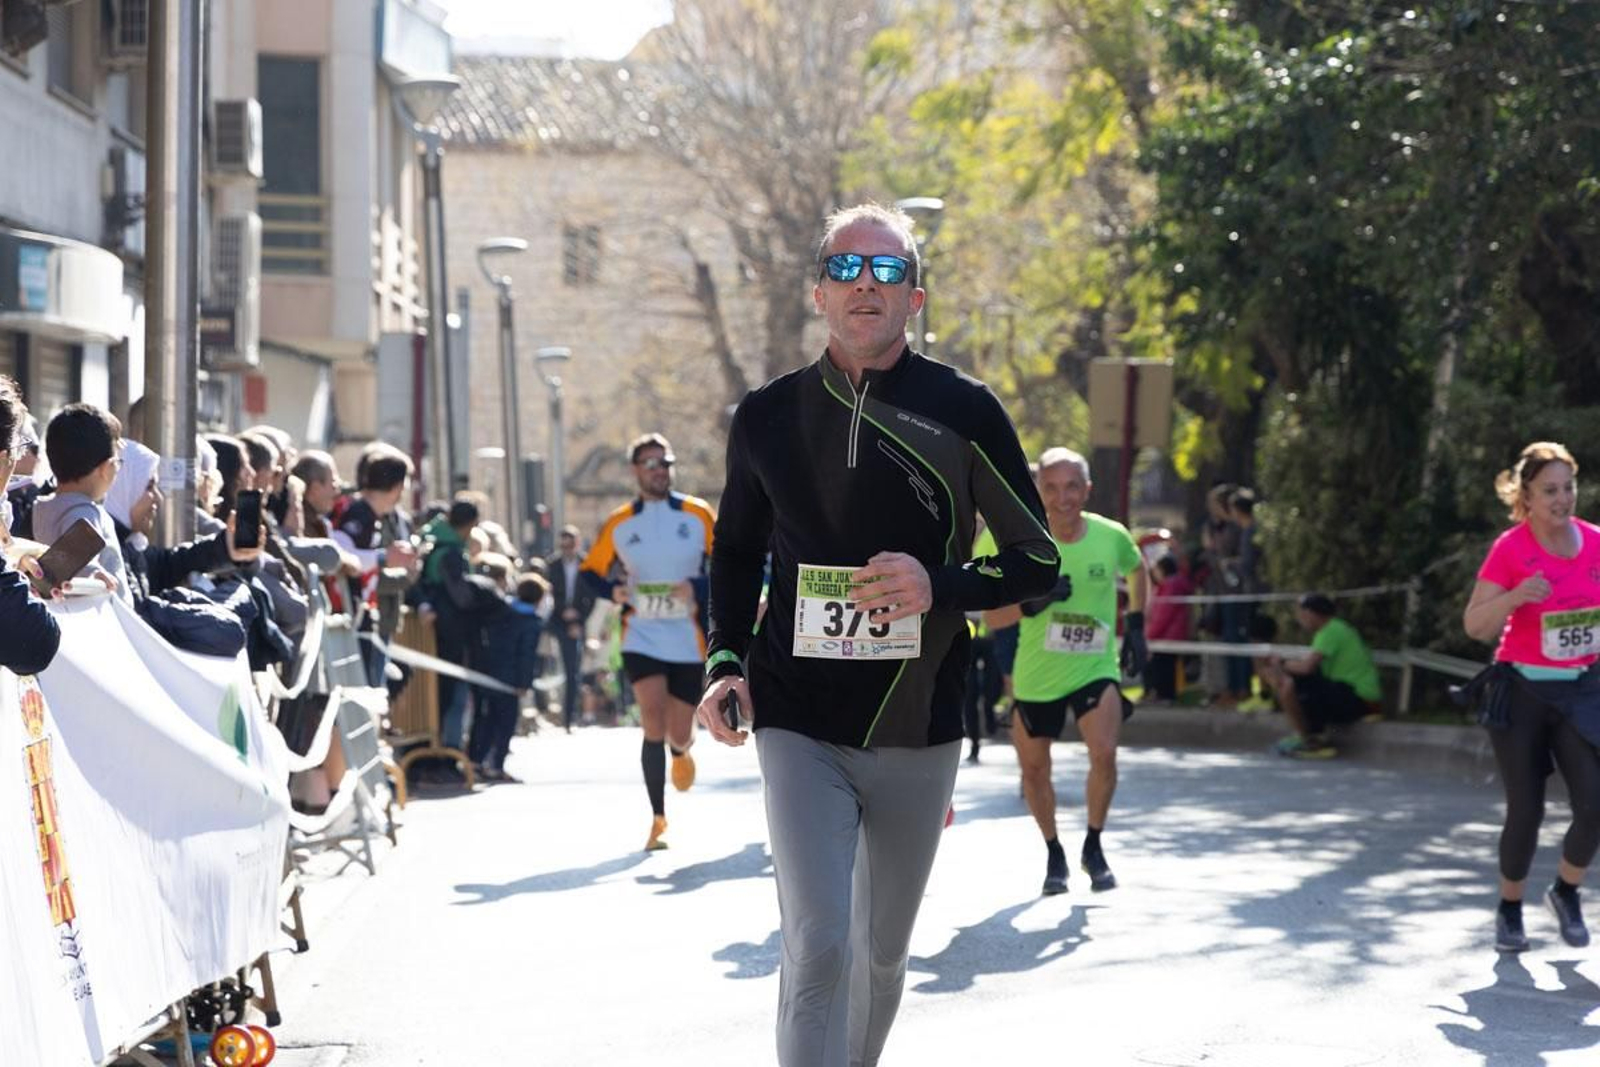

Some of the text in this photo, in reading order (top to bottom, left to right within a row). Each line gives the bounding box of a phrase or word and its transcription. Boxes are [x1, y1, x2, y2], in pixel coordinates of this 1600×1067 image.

[818, 571, 832, 583] SAN
[814, 583, 842, 597] CARRERA
[646, 595, 675, 610] 775
[1061, 626, 1095, 643] 499
[1559, 625, 1593, 648] 565
